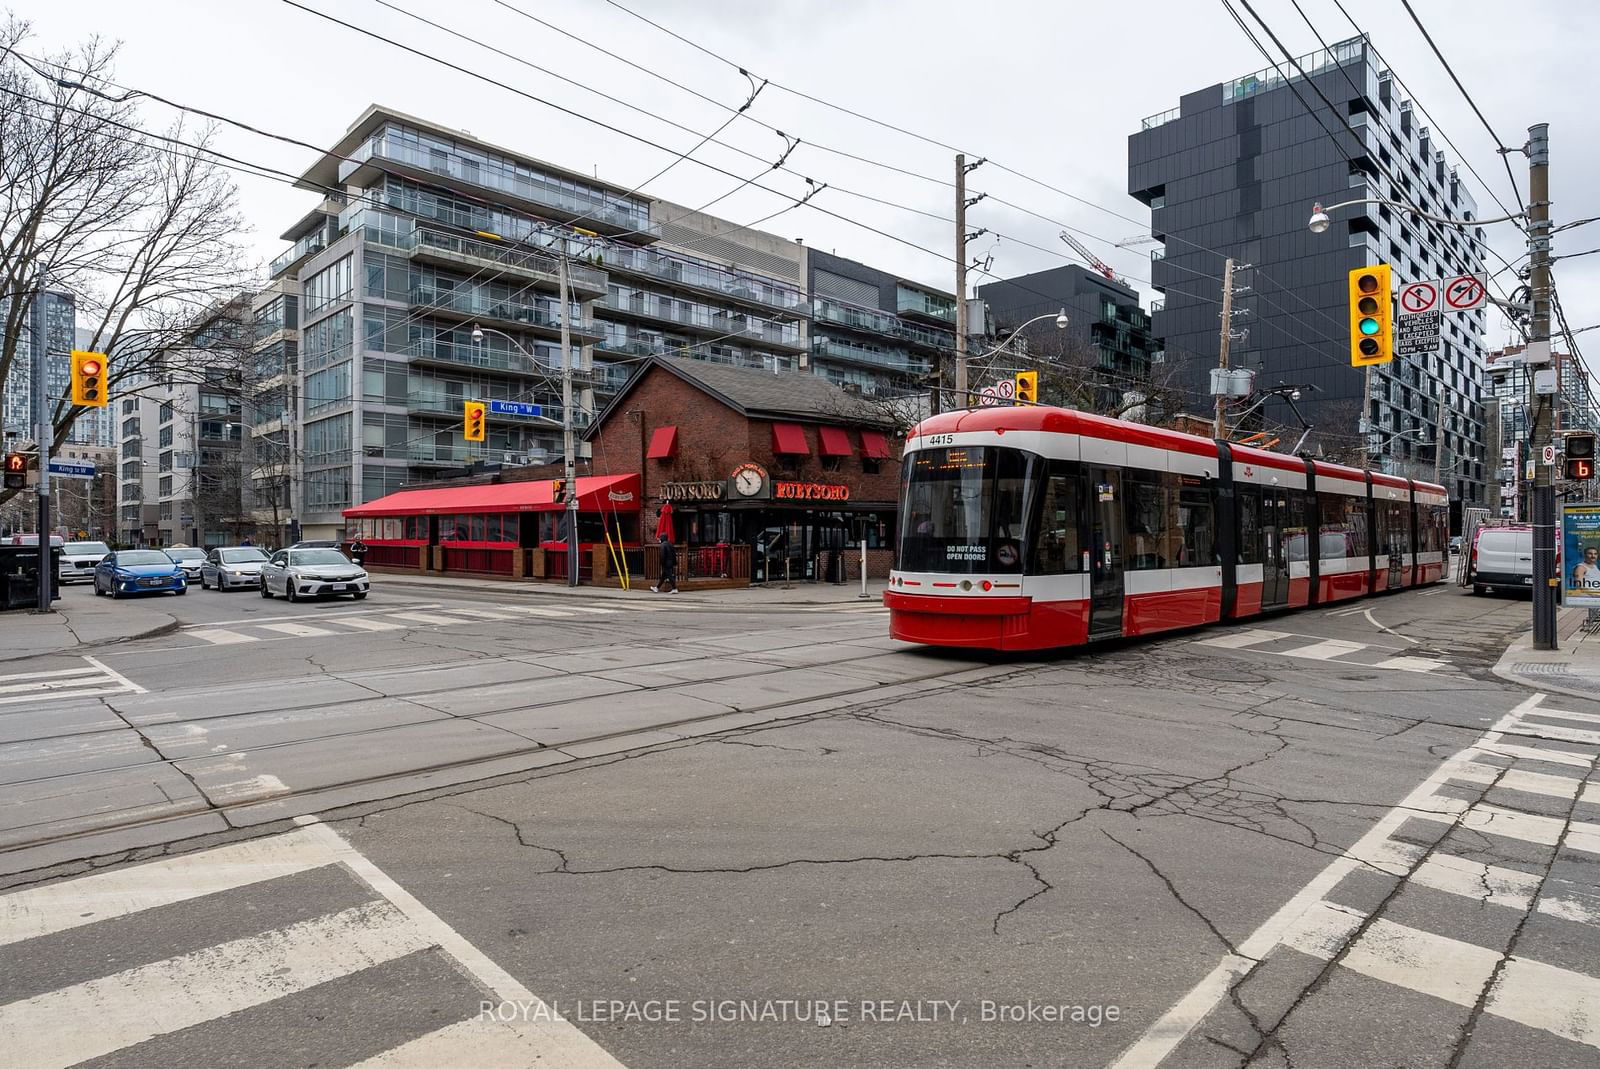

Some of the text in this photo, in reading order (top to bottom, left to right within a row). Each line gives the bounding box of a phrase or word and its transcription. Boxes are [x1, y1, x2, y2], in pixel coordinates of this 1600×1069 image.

[1399, 310, 1439, 321] AUTHORIZED
[1403, 317, 1434, 327] VEHICLES
[1412, 322, 1439, 332] BICYCLES
[1403, 330, 1435, 339] EXCEPTED
[1414, 336, 1439, 346] EXCEPTED
[1400, 346, 1416, 354] 10PM
[500, 402, 518, 414] King
[526, 405, 533, 413] W
[929, 434, 953, 445] 4415
[58, 465, 74, 474] King
[776, 481, 850, 501] RUBYSOHO
[946, 545, 987, 553] DO NOT PASS
[963, 553, 986, 561] DOORS
